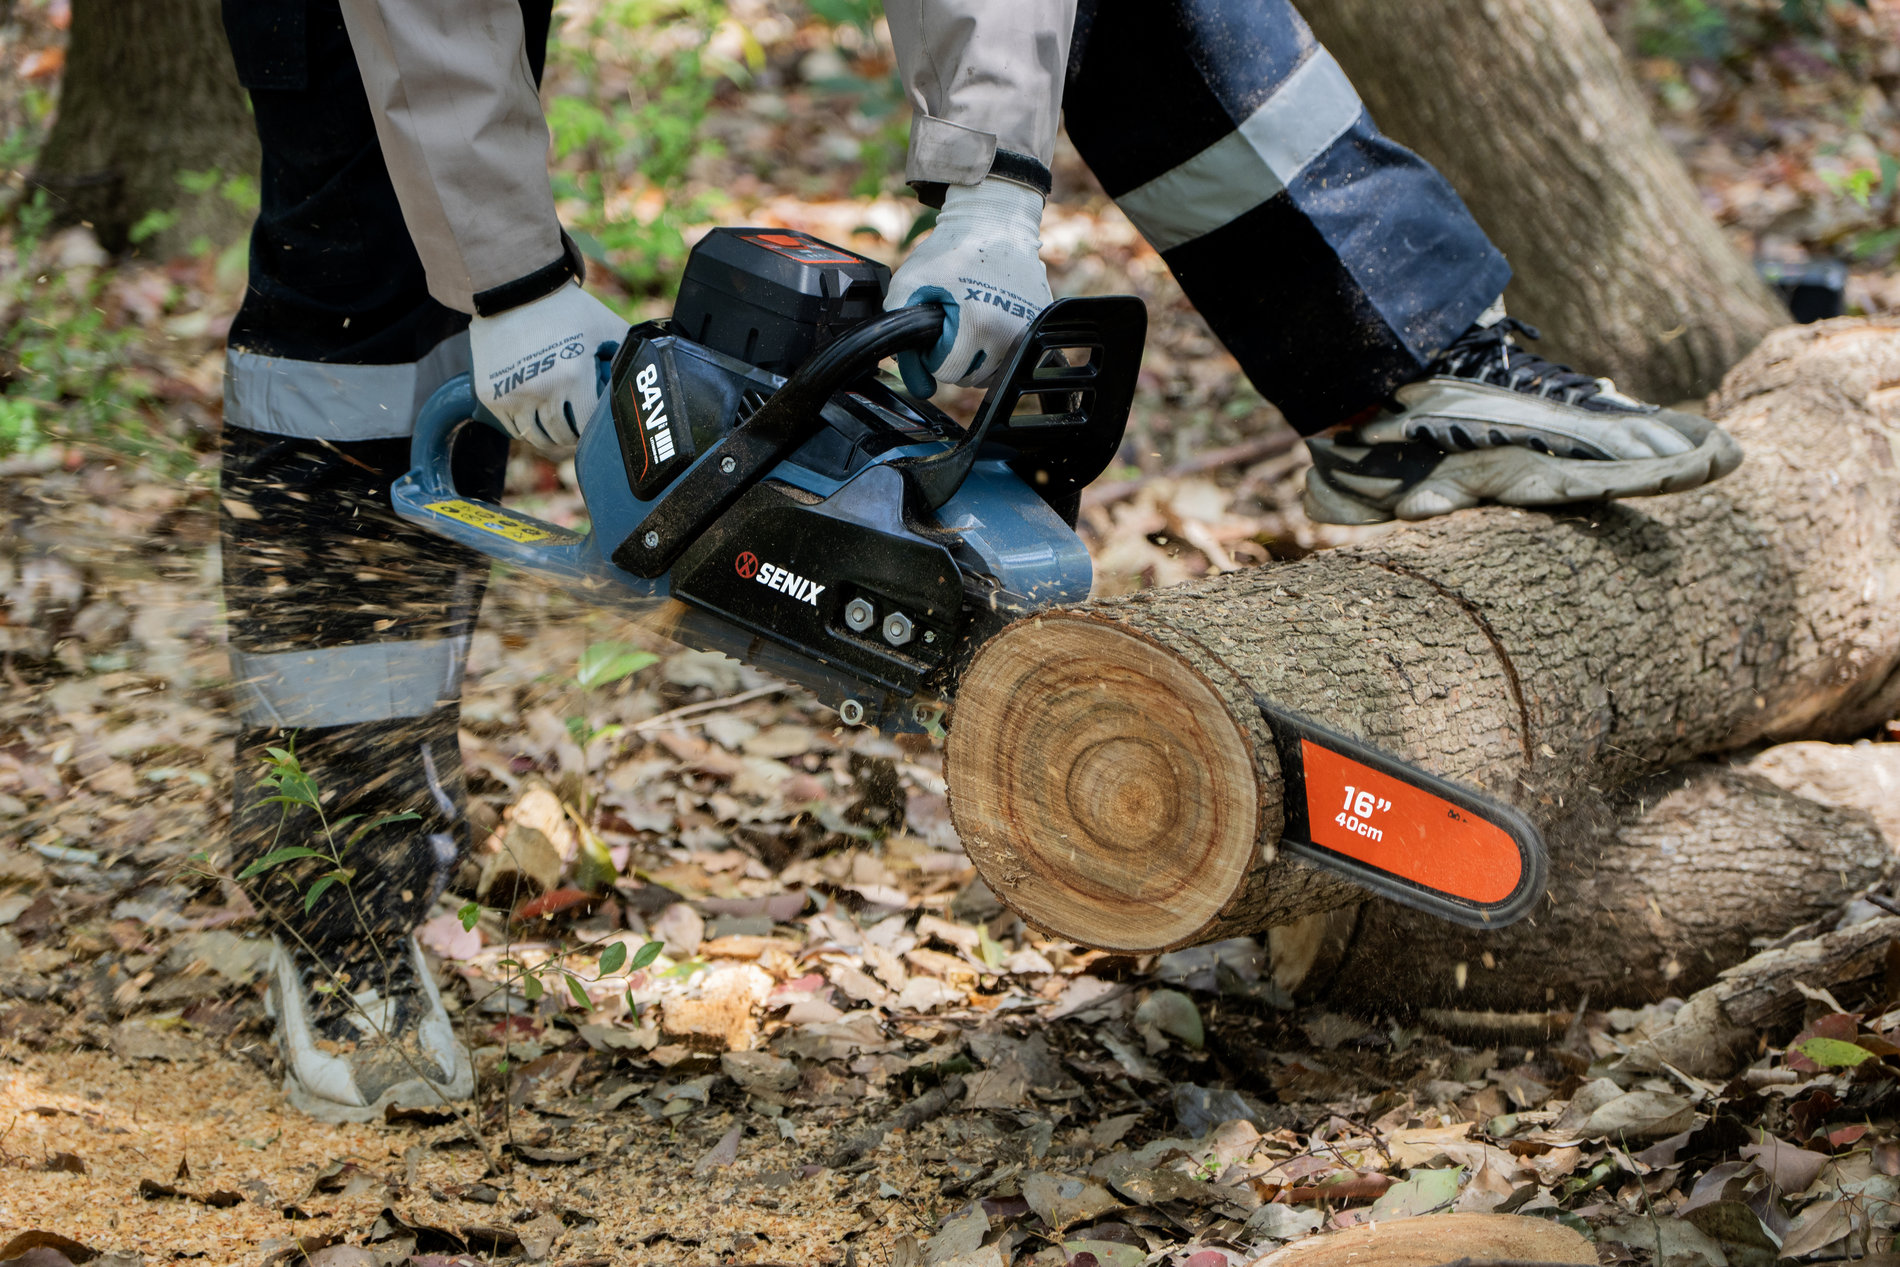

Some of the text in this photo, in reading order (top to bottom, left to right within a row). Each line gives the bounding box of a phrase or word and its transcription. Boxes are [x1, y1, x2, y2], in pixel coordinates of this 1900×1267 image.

[958, 277, 997, 291] POWER
[489, 333, 584, 379] UNSTOPPABLE POWER
[493, 352, 556, 400] SENIX
[636, 363, 668, 430] 84V
[755, 562, 826, 606] SENIX
[1335, 812, 1383, 842] 40cm
